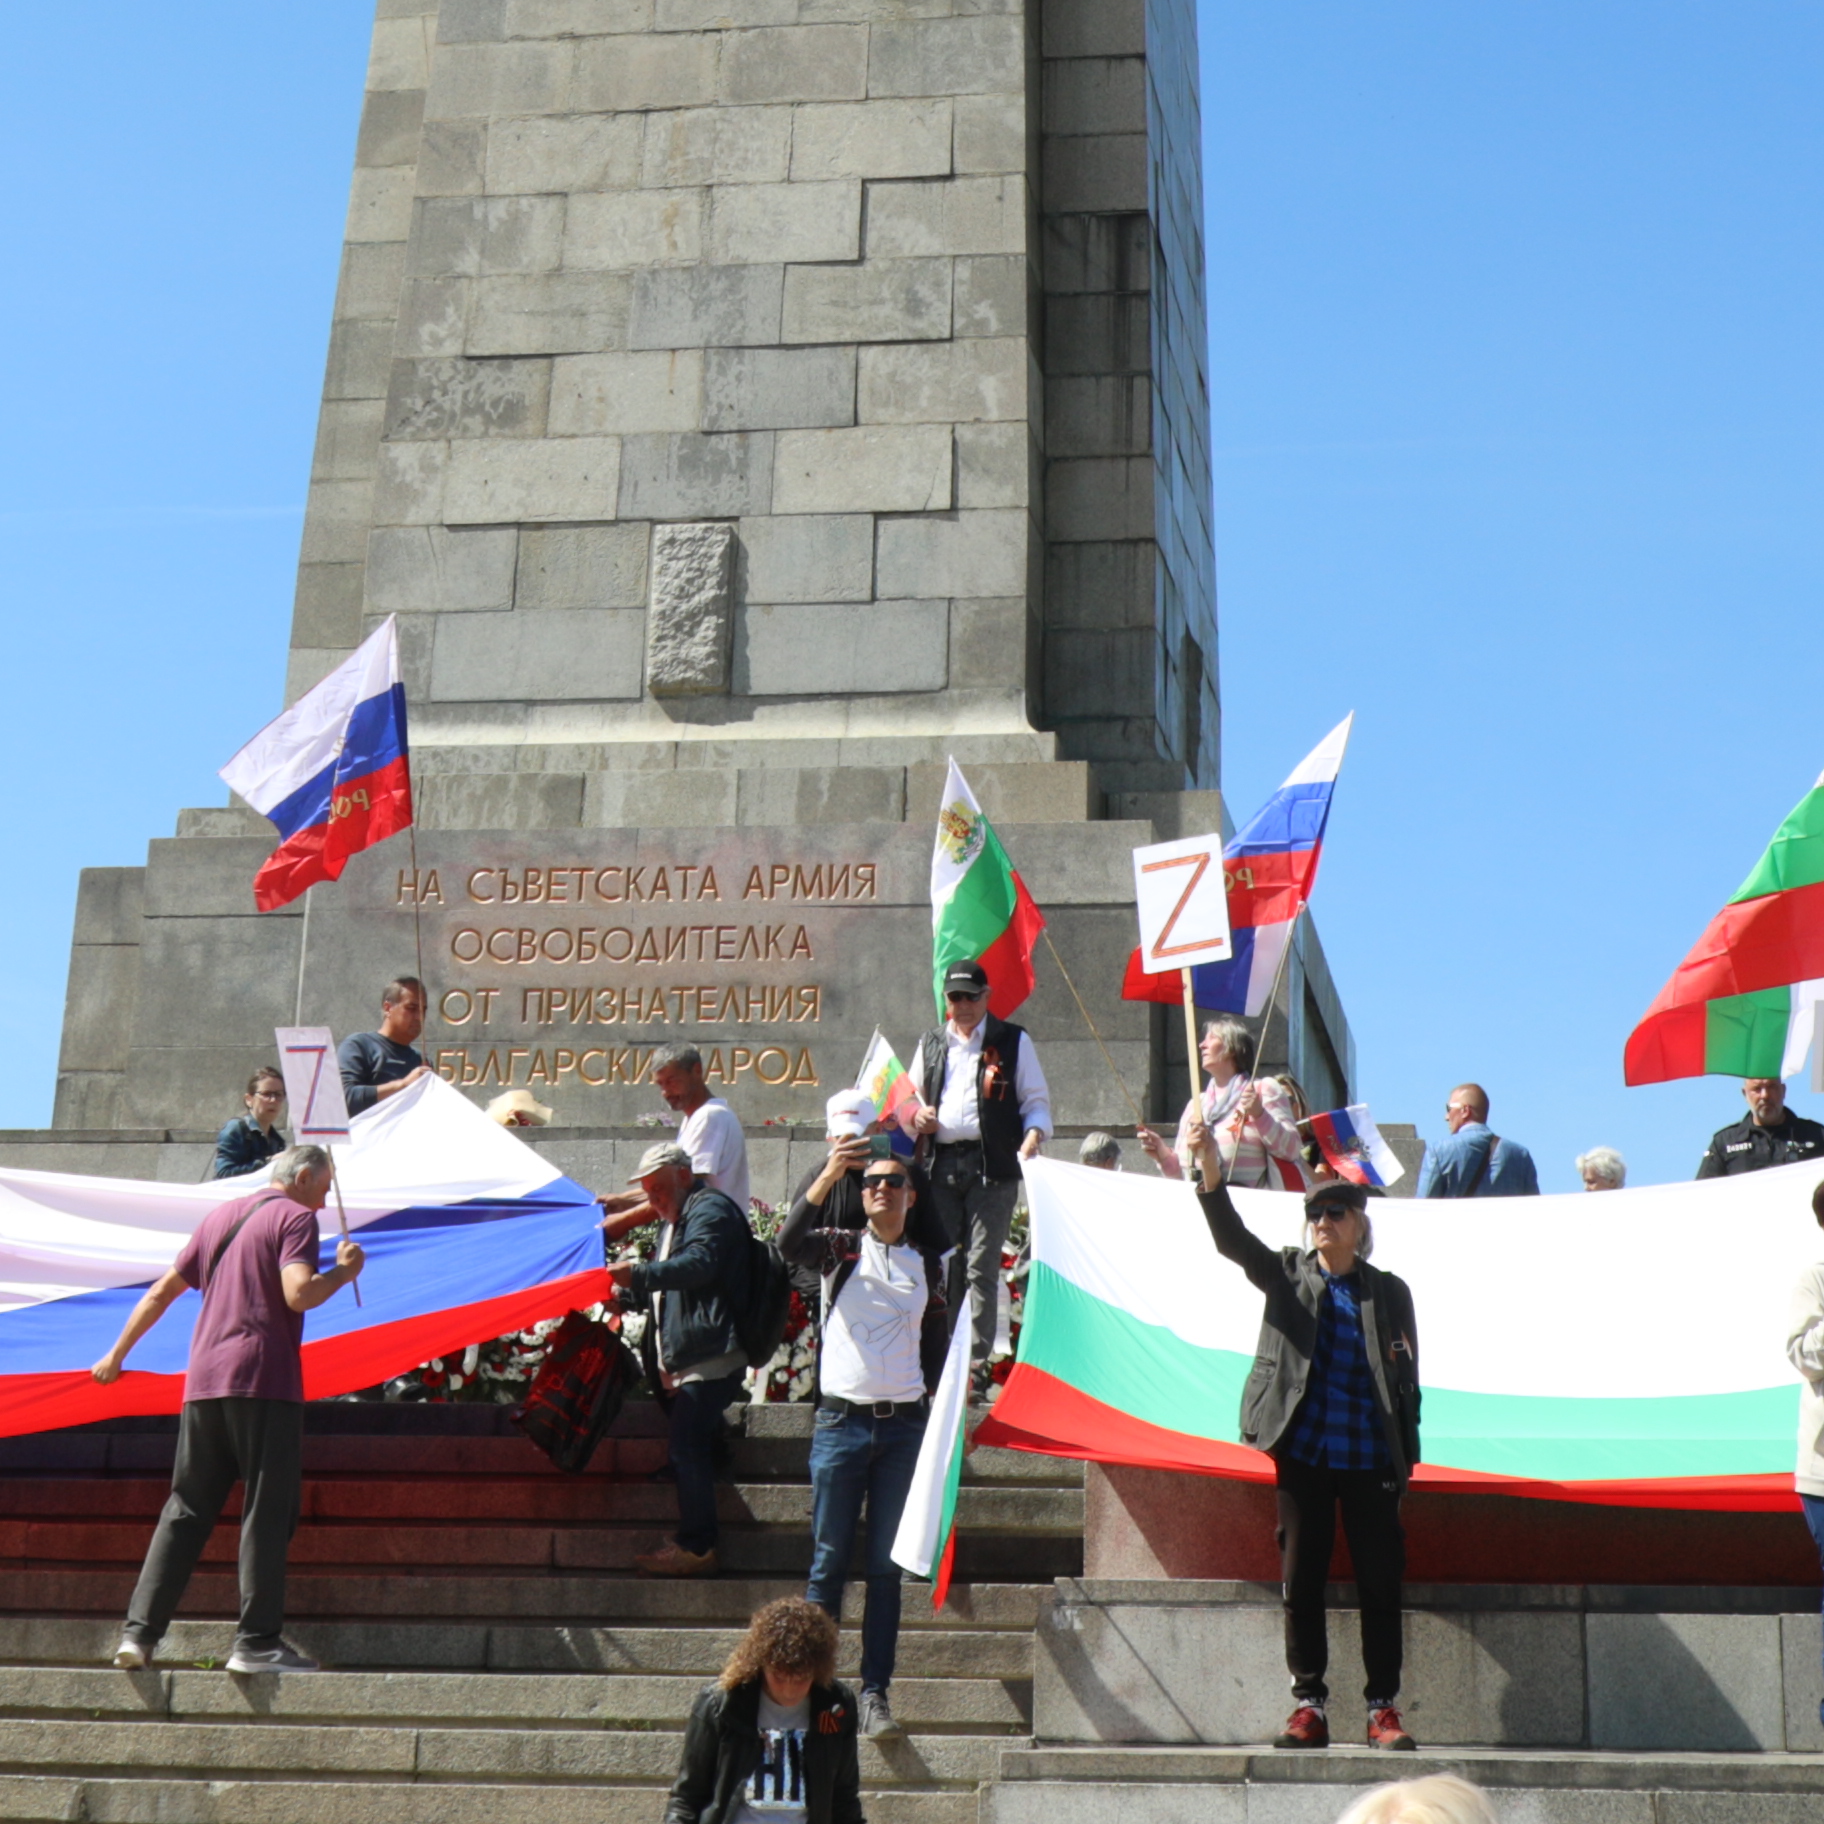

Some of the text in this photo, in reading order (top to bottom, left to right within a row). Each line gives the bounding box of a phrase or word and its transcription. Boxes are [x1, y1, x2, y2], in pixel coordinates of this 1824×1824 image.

[397, 863, 877, 905] НА СЪВЕТСКАТА АРМИЯ
[1141, 852, 1224, 958] Z
[451, 925, 814, 966] ОСВОБОДИТЕЛКА
[439, 985, 821, 1025] ОТ ПРИЗНАТЕЛНИЯ
[701, 1047, 819, 1087] АРОД
